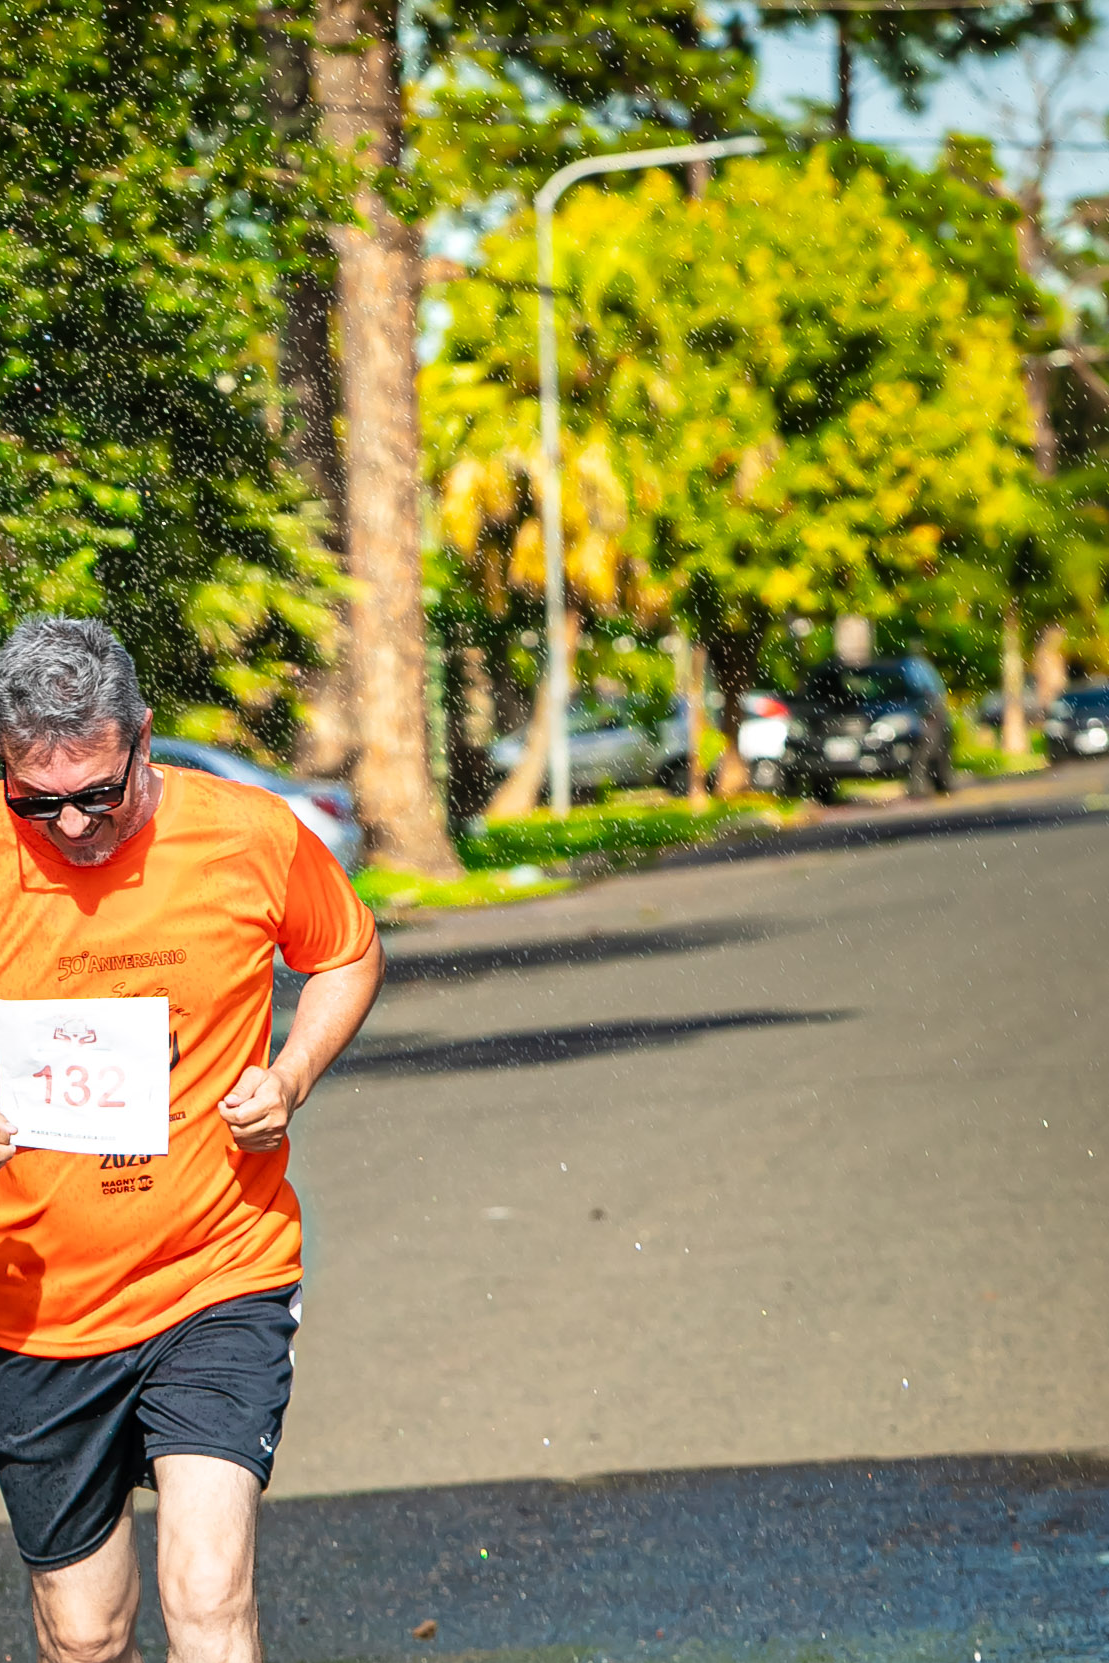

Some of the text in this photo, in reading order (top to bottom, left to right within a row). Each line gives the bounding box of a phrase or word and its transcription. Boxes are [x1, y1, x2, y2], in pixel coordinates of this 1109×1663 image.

[87, 949, 187, 974] ANIVERSARIO
[32, 1064, 126, 1108] 132
[101, 1177, 136, 1188] MAGNY
[102, 1185, 136, 1195] COURS
